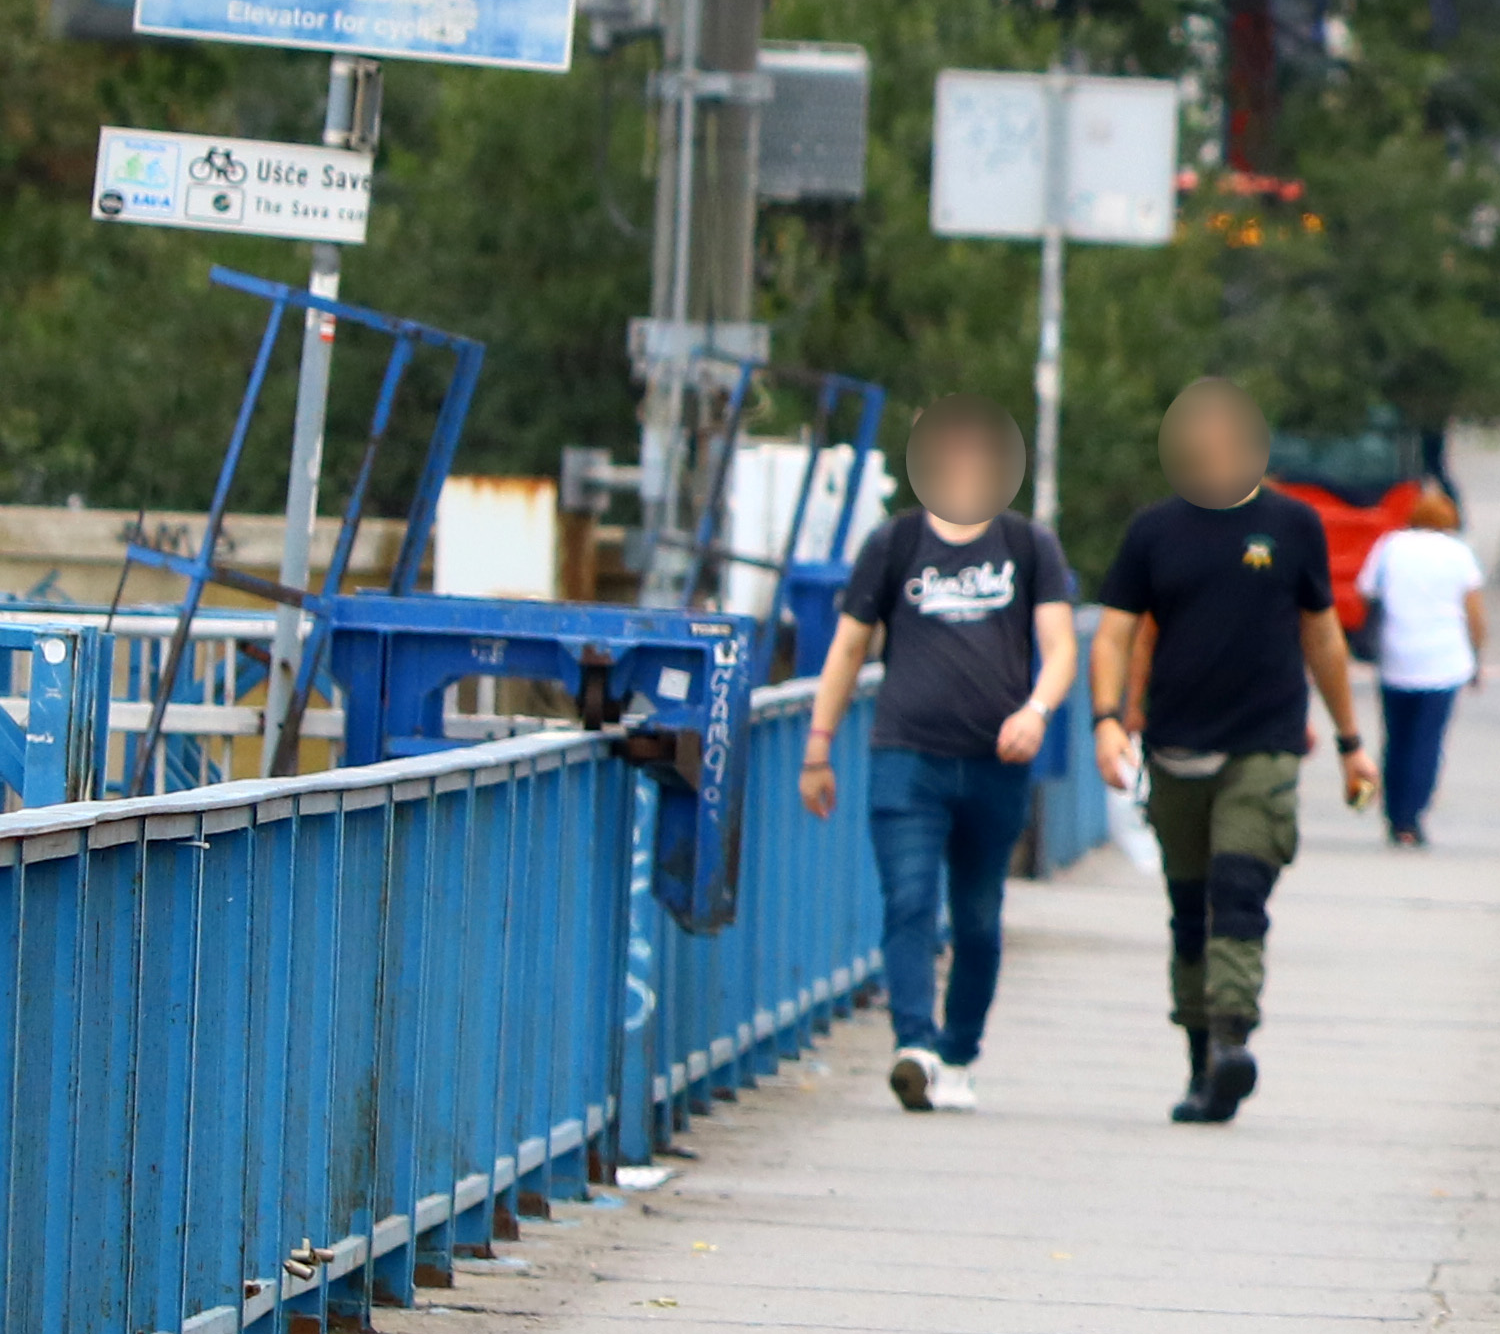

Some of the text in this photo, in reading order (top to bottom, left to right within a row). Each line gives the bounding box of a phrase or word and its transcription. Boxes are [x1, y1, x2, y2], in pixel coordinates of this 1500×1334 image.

[227, 0, 327, 29] Elevator
[334, 9, 367, 34] for
[257, 158, 308, 186] Ušće
[255, 196, 281, 214] The
[292, 200, 328, 218] Sava
